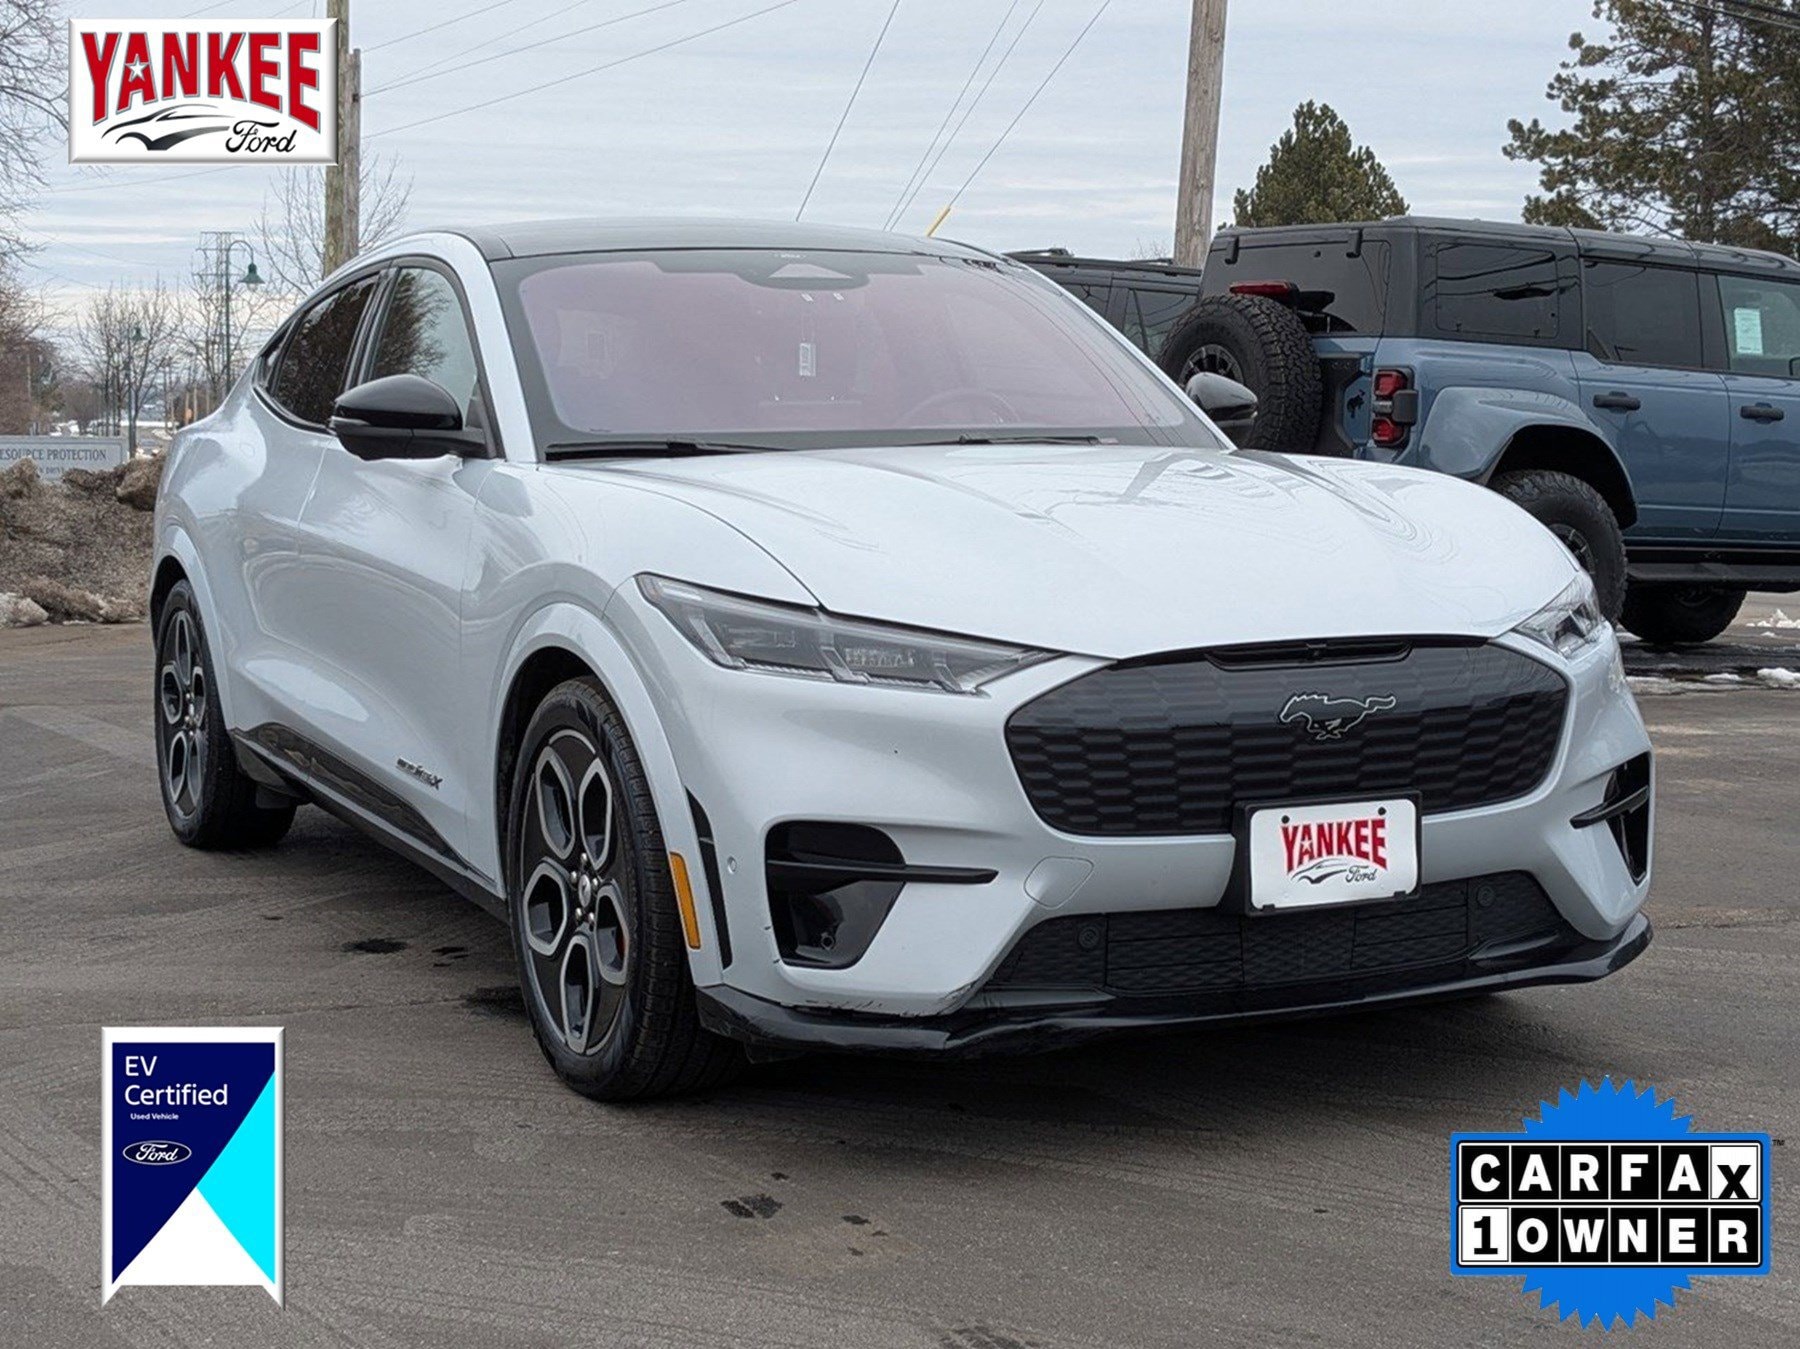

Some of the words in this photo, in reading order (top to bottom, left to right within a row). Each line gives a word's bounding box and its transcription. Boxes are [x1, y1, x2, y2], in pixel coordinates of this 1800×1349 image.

[47, 448, 107, 460] PROTECTION
[1281, 818, 1388, 876] YANKEE
[1345, 865, 1377, 883] Ford
